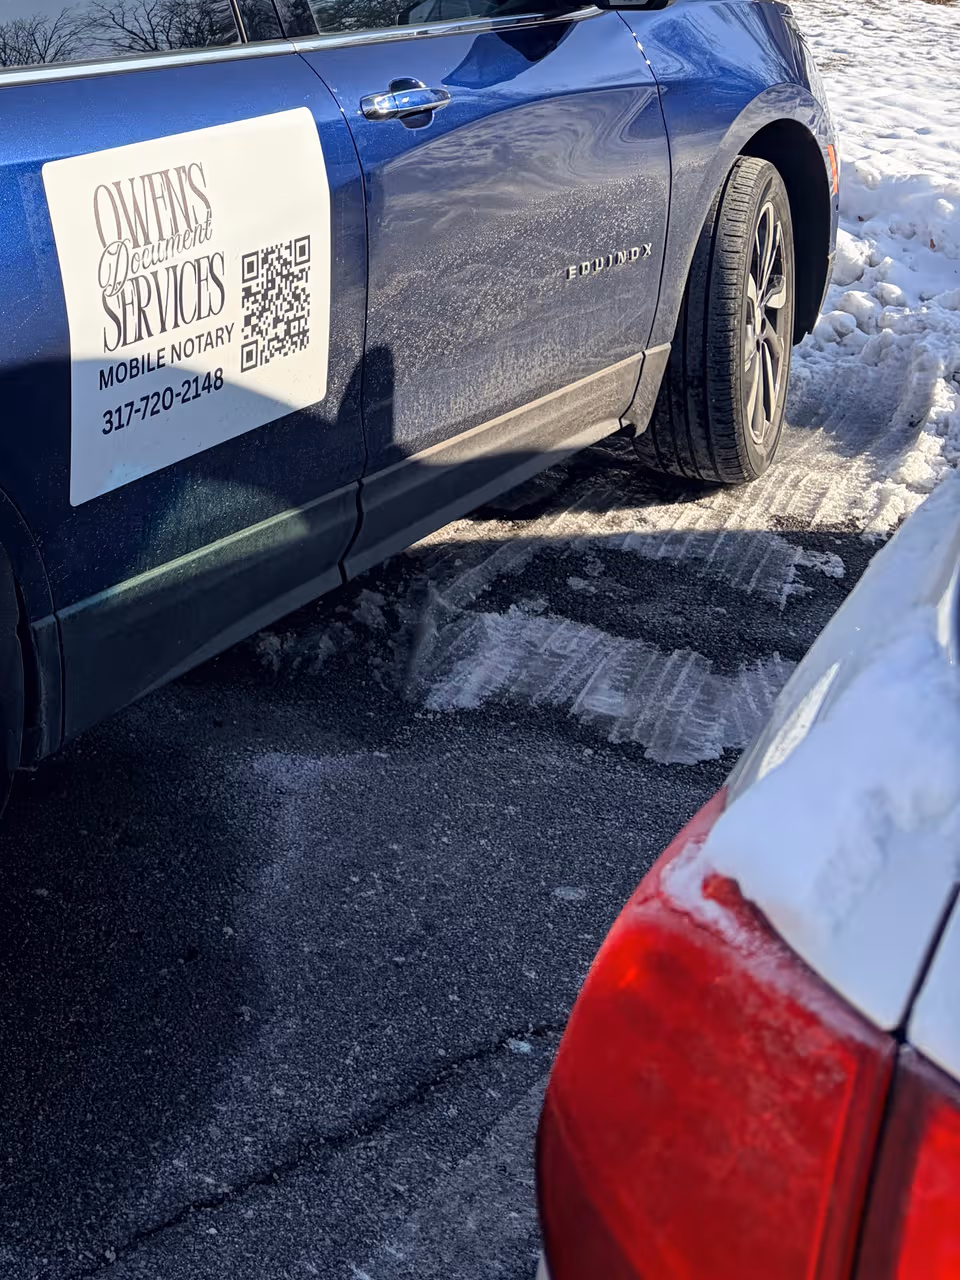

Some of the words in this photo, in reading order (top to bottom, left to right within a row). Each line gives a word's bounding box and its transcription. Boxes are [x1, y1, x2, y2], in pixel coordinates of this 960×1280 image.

[93, 161, 212, 249] OWEN'S
[98, 210, 213, 297] Document
[101, 251, 225, 353] SERVICES
[99, 347, 166, 391] MOBILE
[170, 322, 235, 364] NOTARY
[102, 367, 224, 435] 317-720-2148
